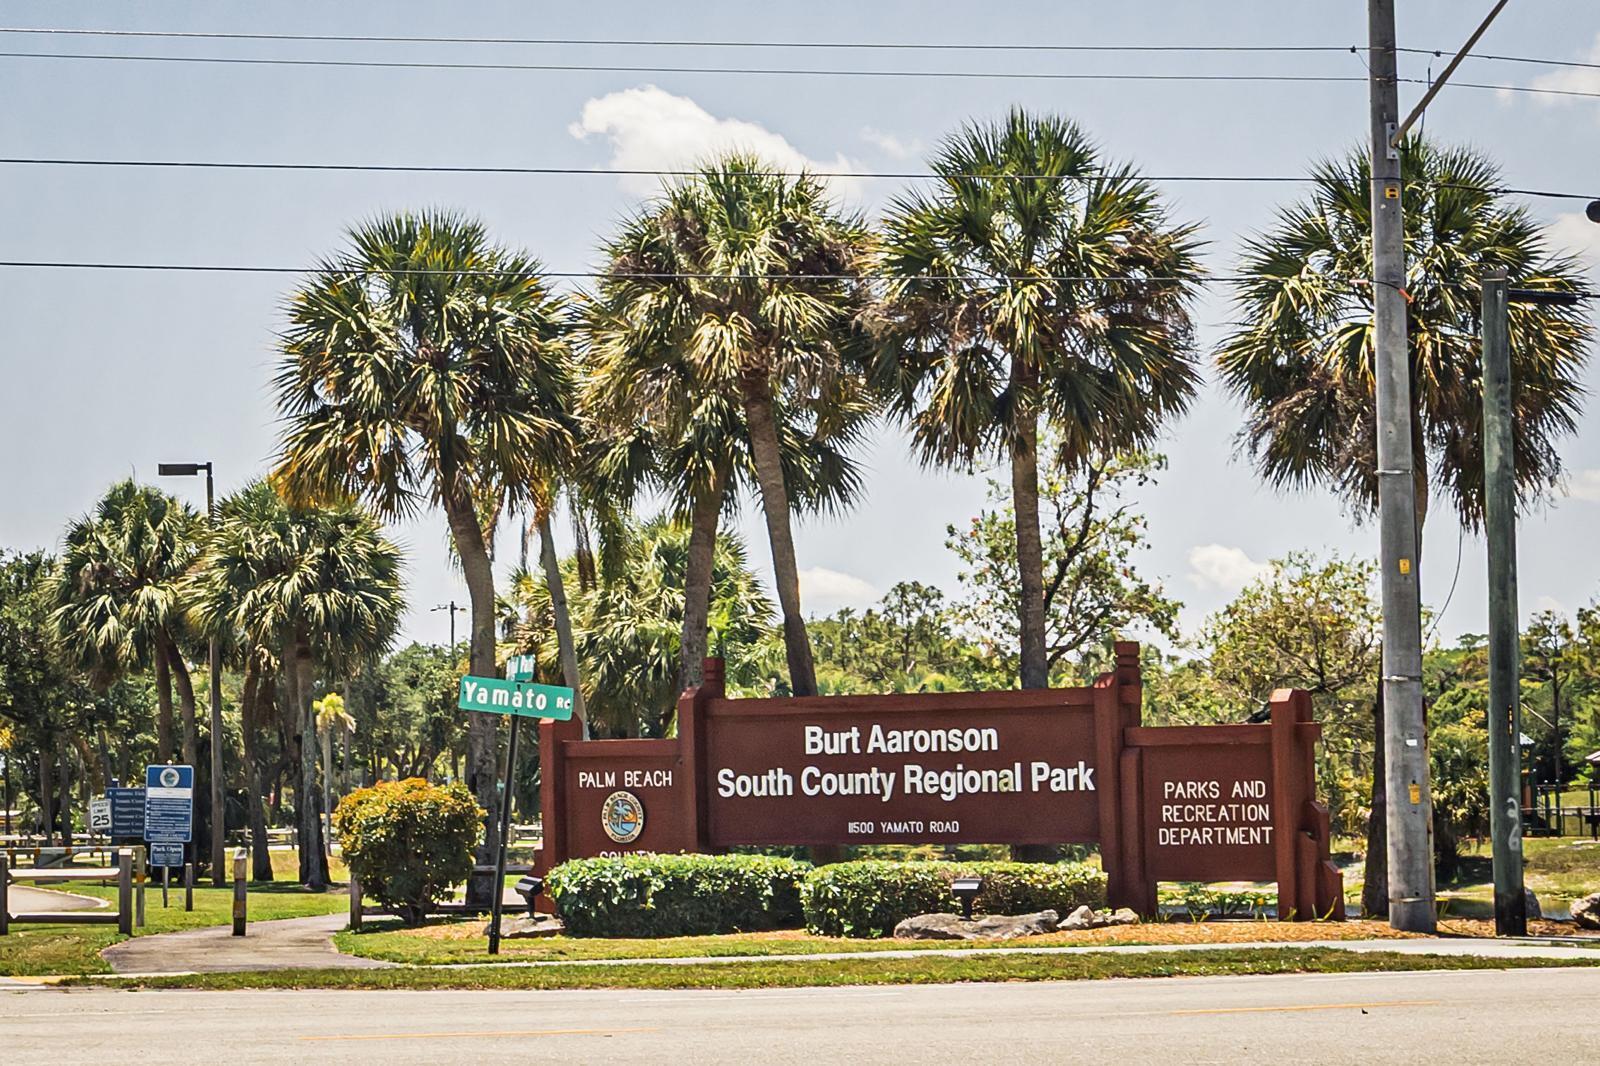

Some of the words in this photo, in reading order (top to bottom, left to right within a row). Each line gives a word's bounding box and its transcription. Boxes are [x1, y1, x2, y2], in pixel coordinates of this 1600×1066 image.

[464, 681, 547, 710] Yamato
[804, 725, 860, 754] Burt
[866, 724, 998, 753] Aaronson
[579, 771, 616, 788] PALM
[624, 770, 673, 787] BEACH
[717, 767, 793, 797] South
[801, 766, 896, 802] County
[904, 762, 1022, 801] Regional
[1031, 761, 1095, 791] Park
[1164, 781, 1220, 799] PARKS
[1231, 780, 1266, 798] AND
[92, 814, 110, 827] 25
[1162, 804, 1270, 823] RECREATION
[880, 821, 924, 833] YAMATO
[930, 821, 960, 833] ROAD
[1159, 826, 1273, 845] DEPARTMENT
